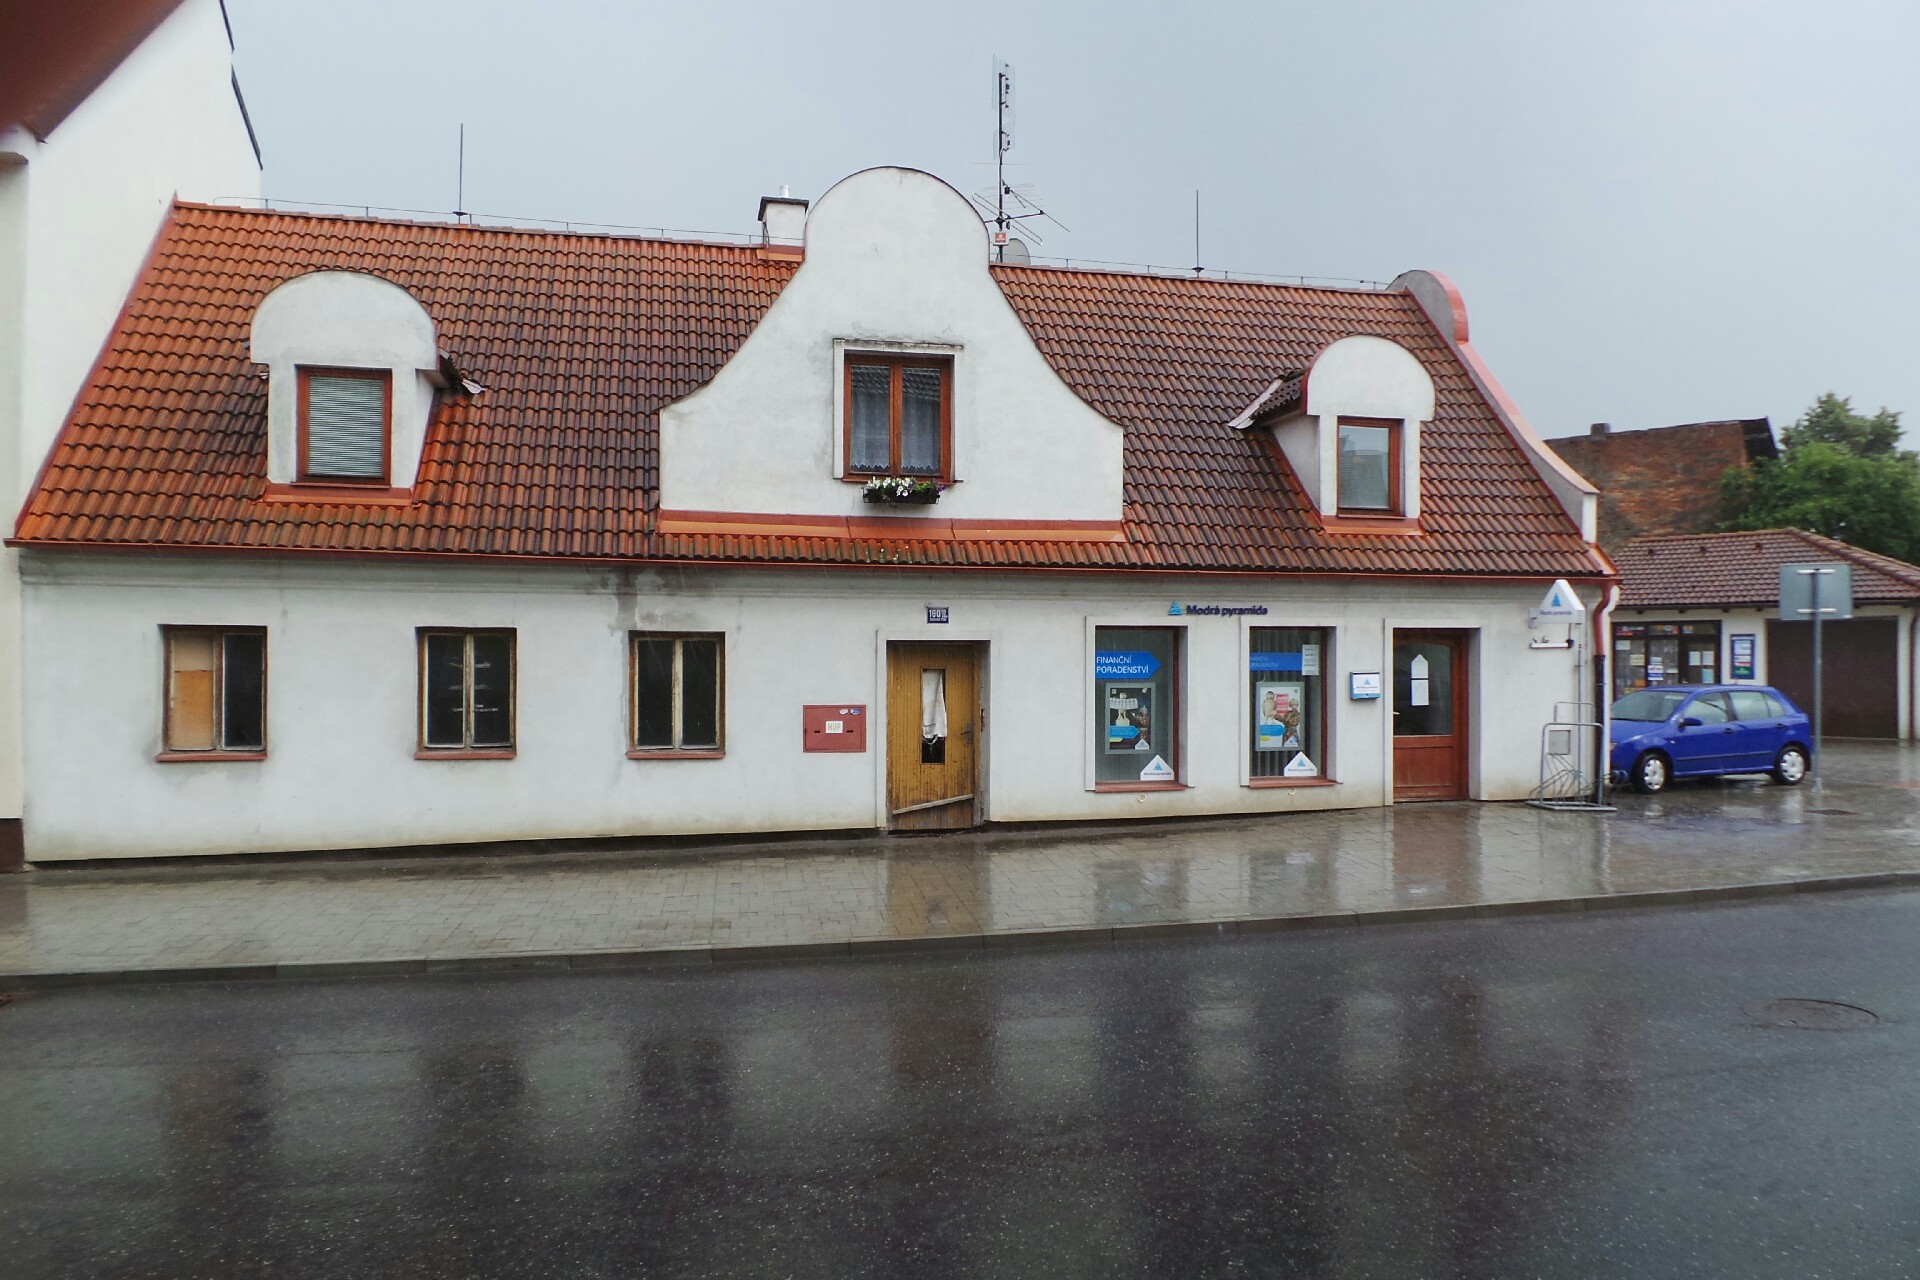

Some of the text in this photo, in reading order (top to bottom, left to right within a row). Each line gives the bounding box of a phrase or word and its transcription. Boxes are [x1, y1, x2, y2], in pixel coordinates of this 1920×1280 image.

[1186, 605, 1268, 617] Modrá pyramida
[1096, 655, 1132, 664] FINANČNÍ
[1096, 664, 1149, 674] PORADENSTVÍ
